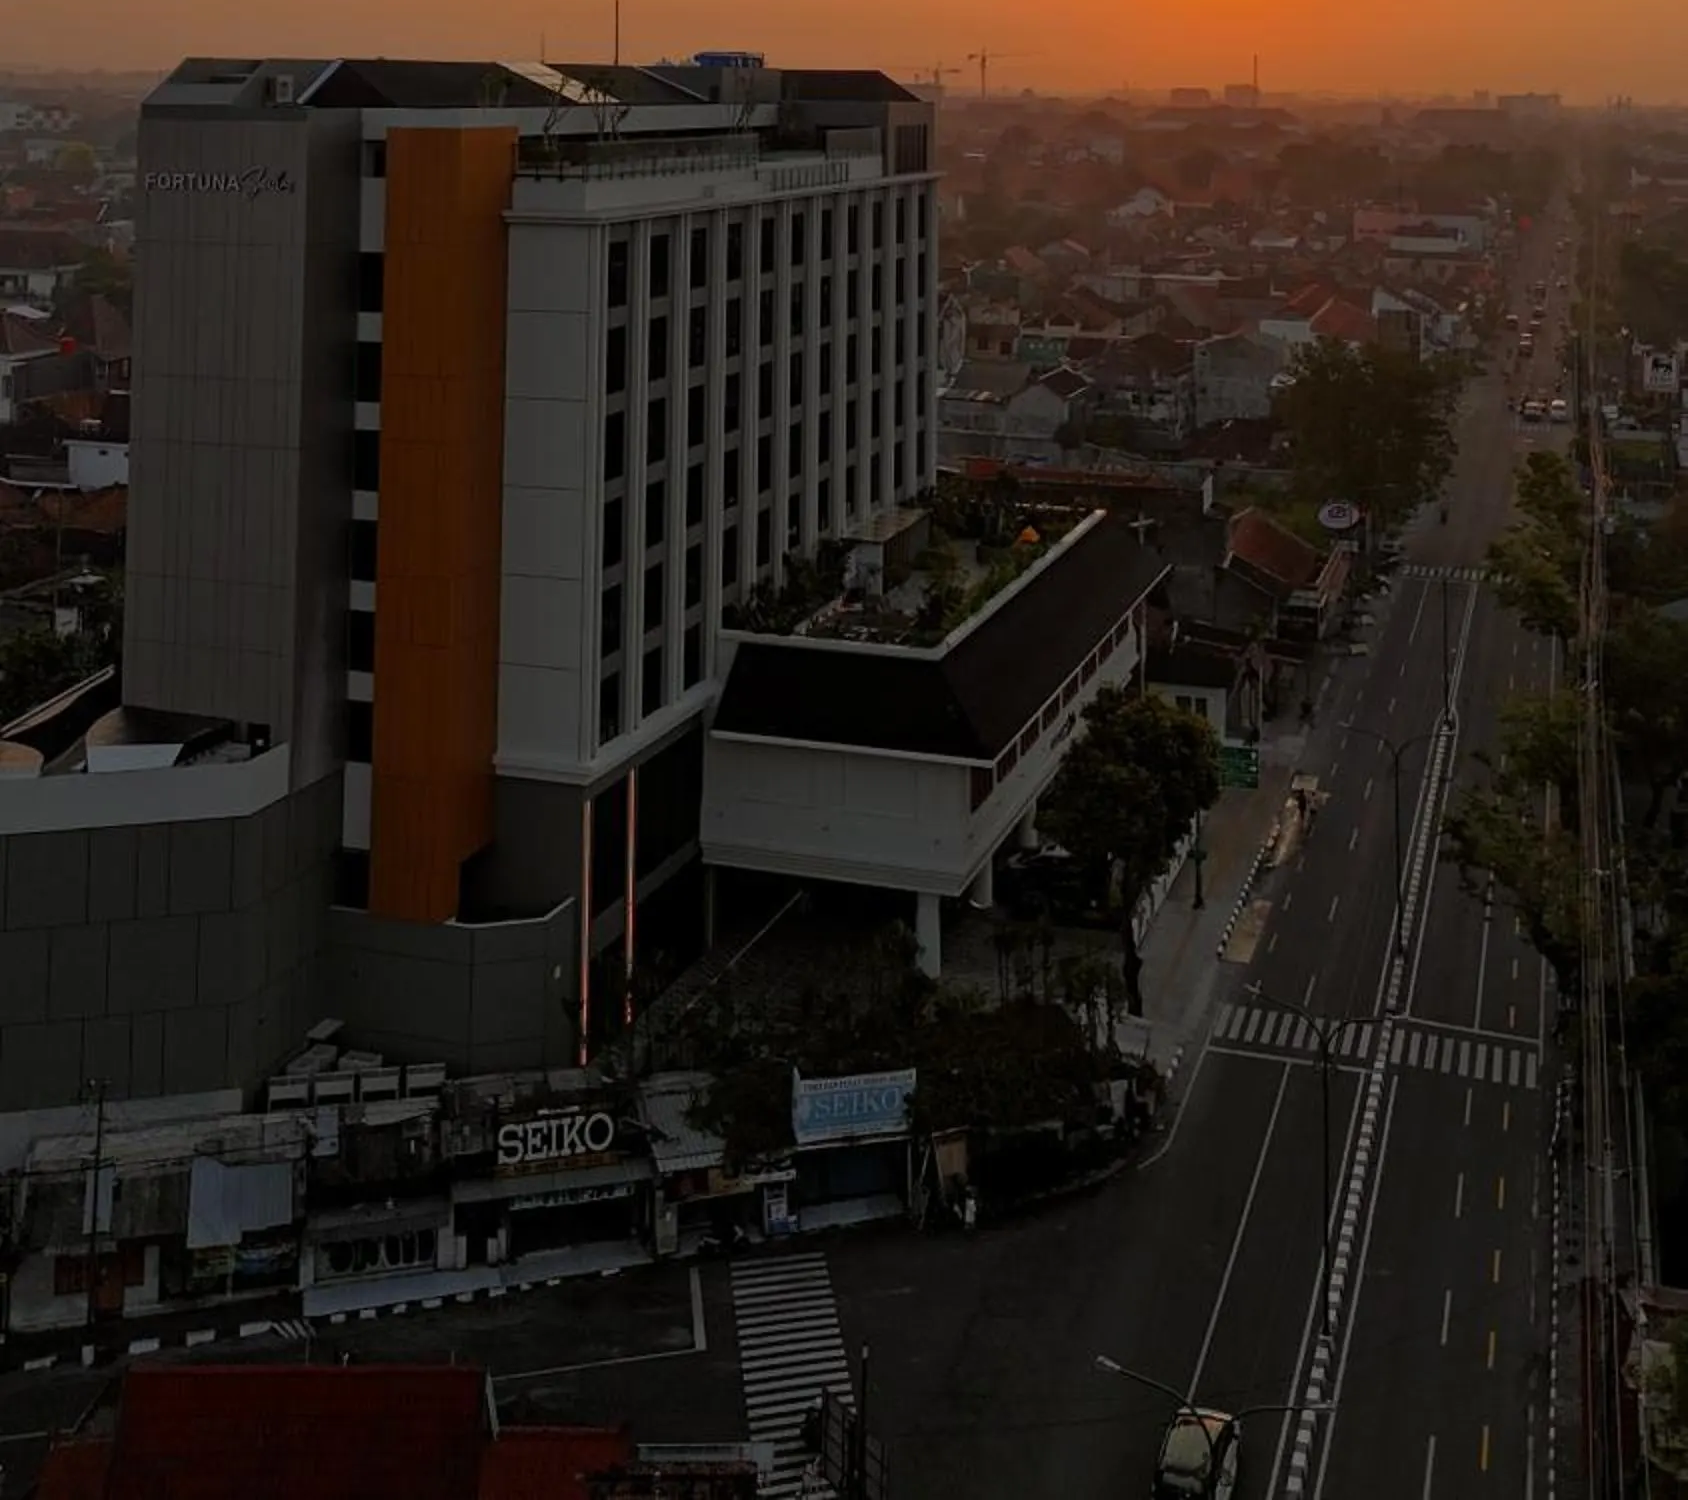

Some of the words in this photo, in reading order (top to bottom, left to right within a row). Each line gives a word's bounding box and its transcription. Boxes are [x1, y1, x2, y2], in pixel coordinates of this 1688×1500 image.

[145, 172, 239, 192] FORTUNA
[814, 1087, 900, 1119] SEIKO
[497, 1112, 615, 1165] SEIKO
